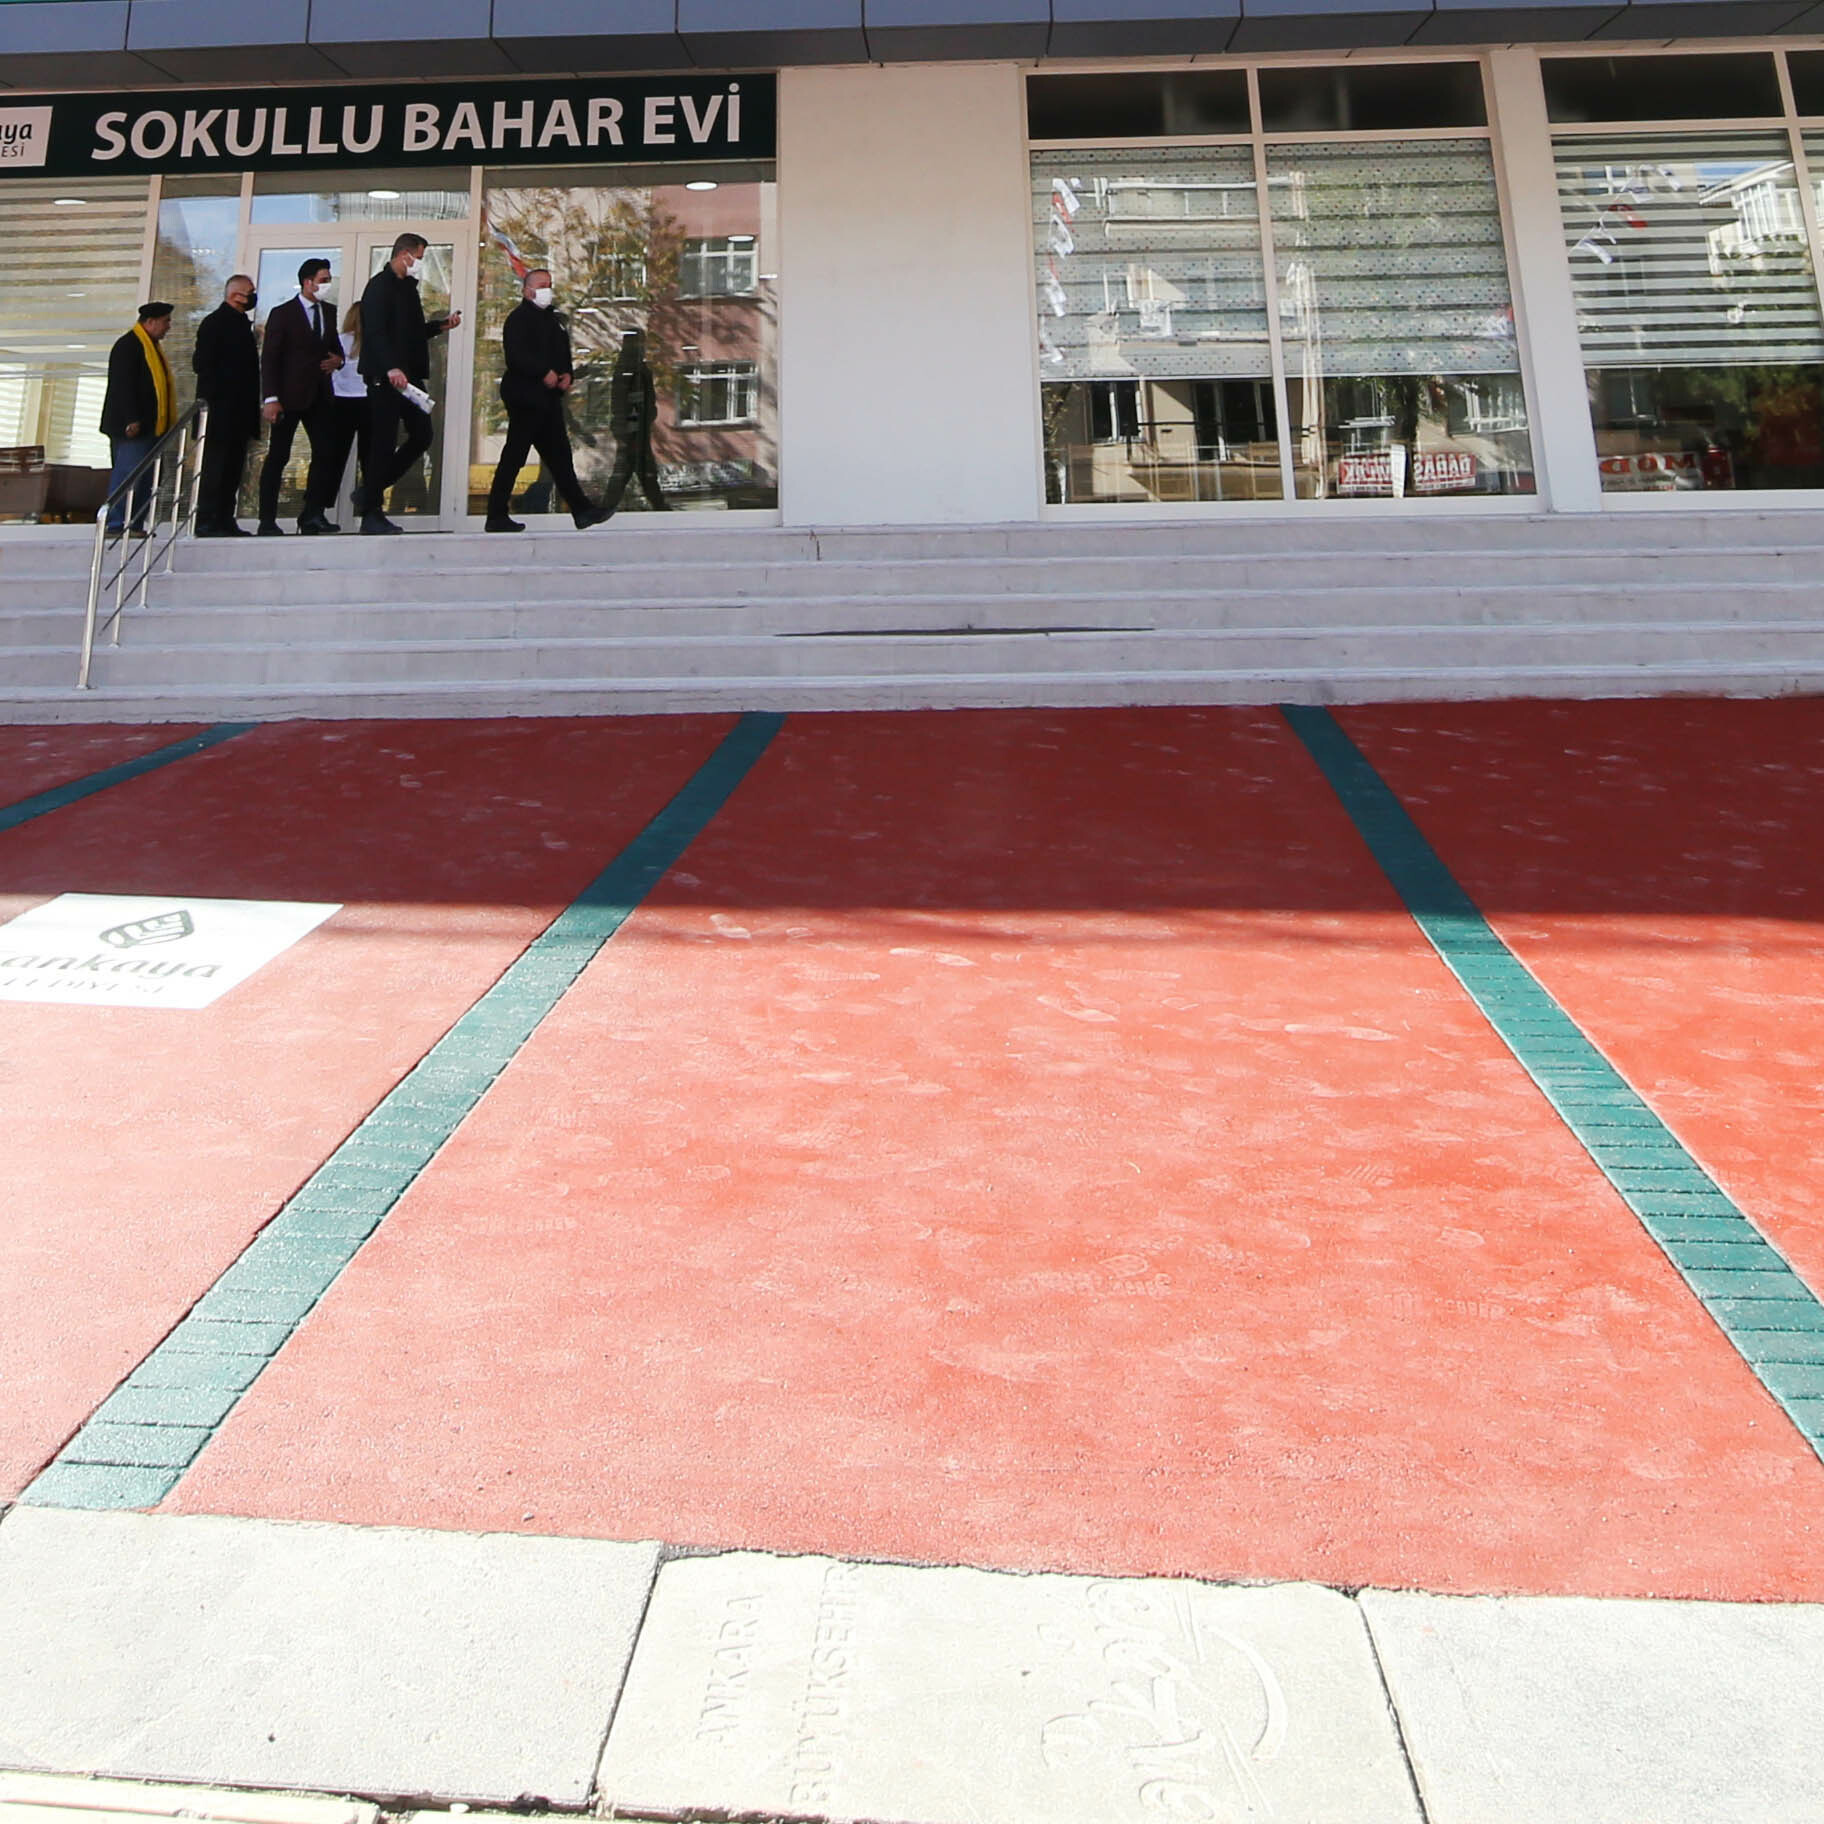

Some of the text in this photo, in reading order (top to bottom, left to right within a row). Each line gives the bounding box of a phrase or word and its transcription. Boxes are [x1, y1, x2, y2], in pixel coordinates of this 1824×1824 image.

[91, 82, 741, 161] SOKULLU BAHAR EVİ
